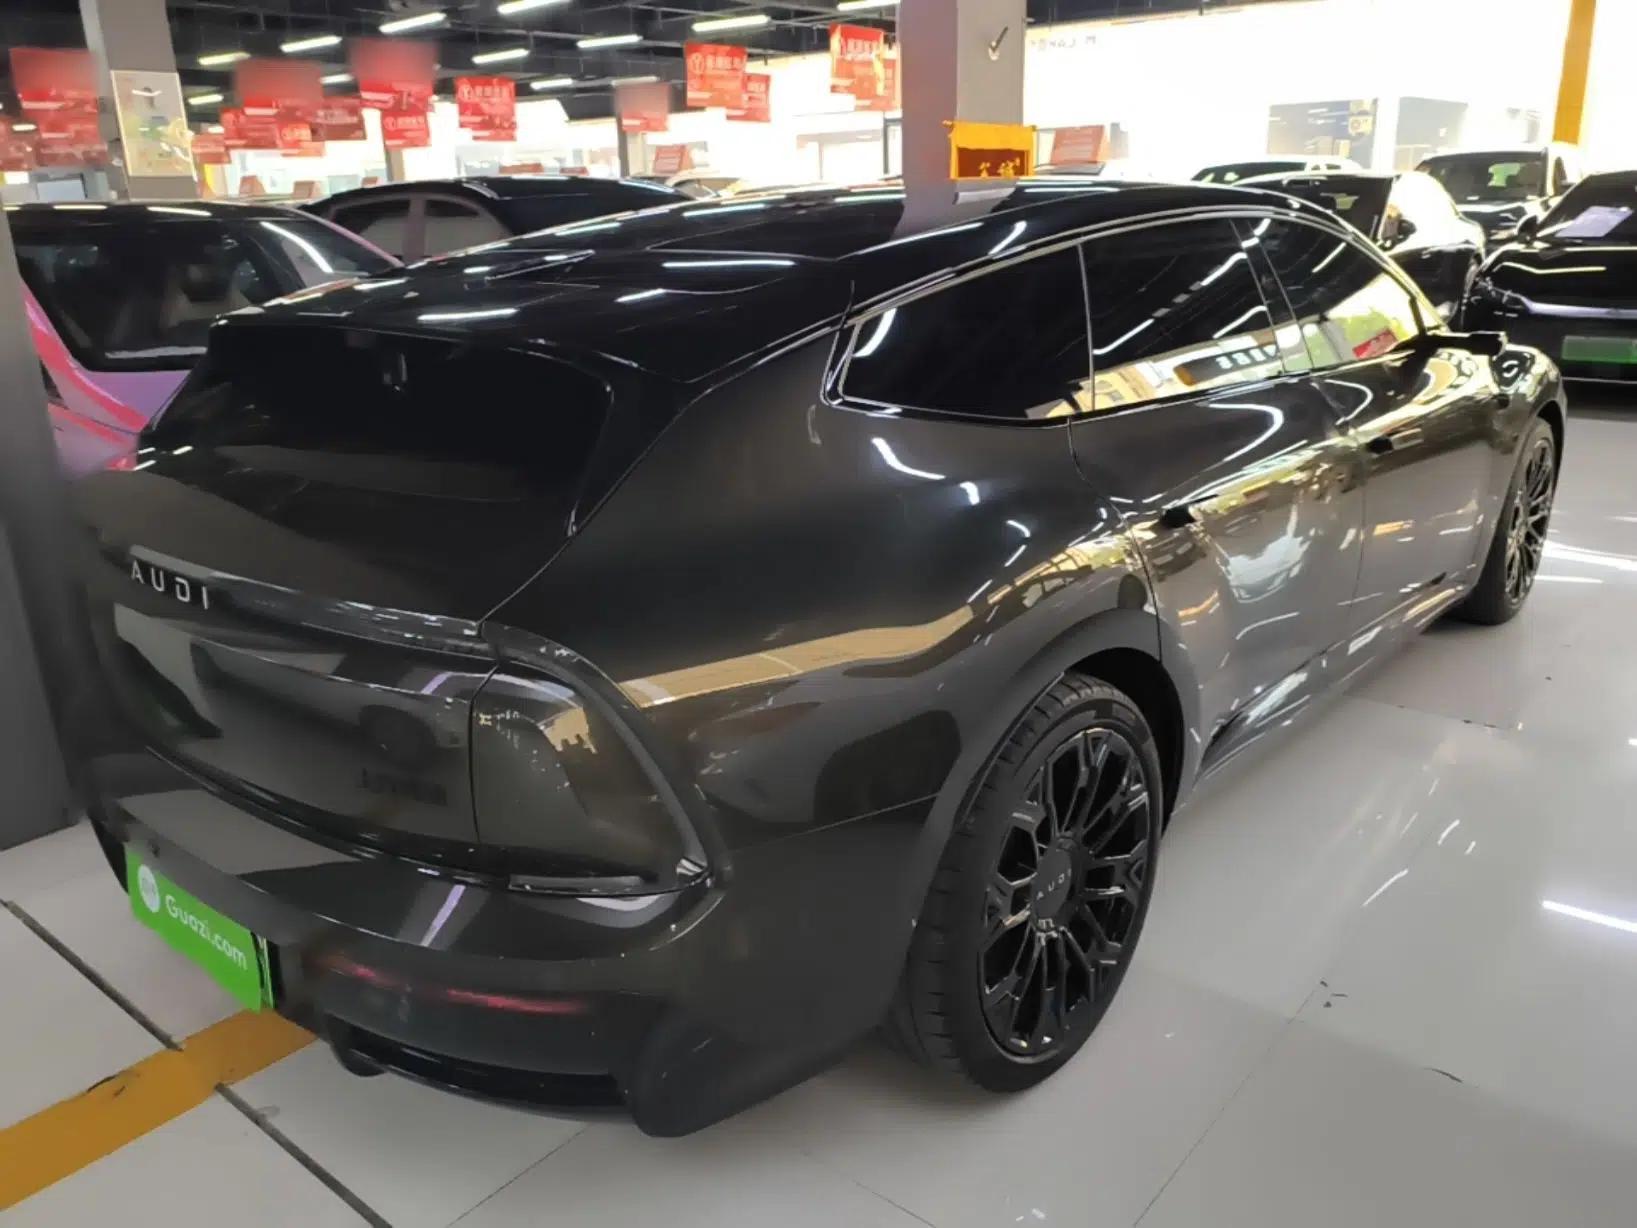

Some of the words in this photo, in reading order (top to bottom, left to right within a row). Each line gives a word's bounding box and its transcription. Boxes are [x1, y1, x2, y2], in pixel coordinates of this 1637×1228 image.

[131, 560, 209, 611] AUDI
[1036, 868, 1072, 901] AUDI
[165, 894, 249, 971] Guazi.com
